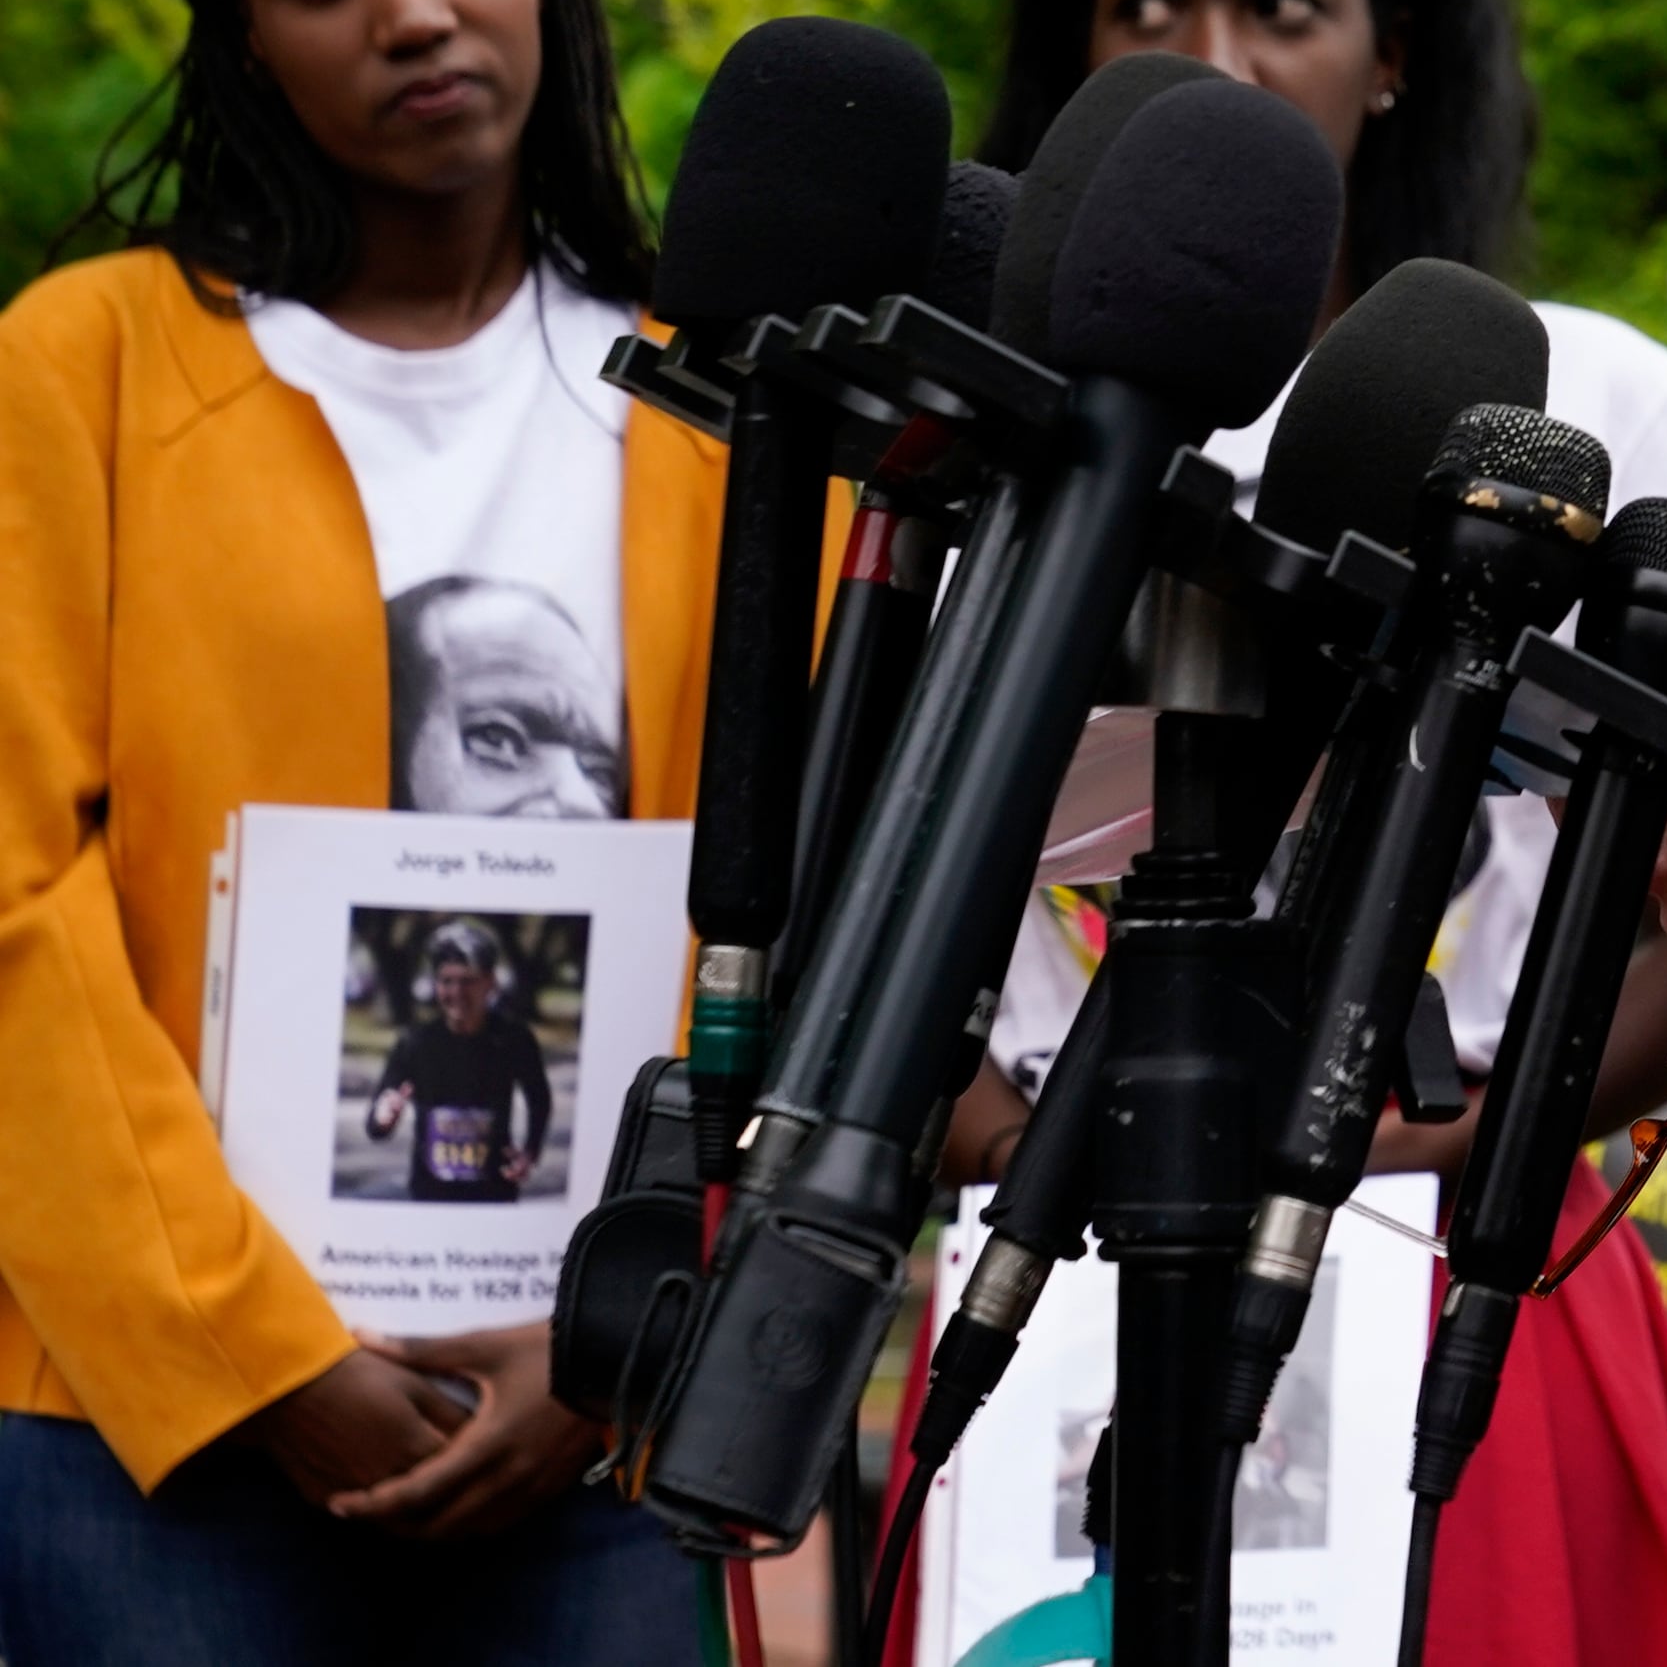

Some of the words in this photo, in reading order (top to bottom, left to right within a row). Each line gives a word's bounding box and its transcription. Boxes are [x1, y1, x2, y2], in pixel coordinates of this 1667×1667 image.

[395, 846, 466, 880] Jorge
[475, 849, 556, 878] Toledo
[321, 1242, 437, 1268] American
[445, 1246, 542, 1275] Hostage
[428, 1278, 460, 1302] for
